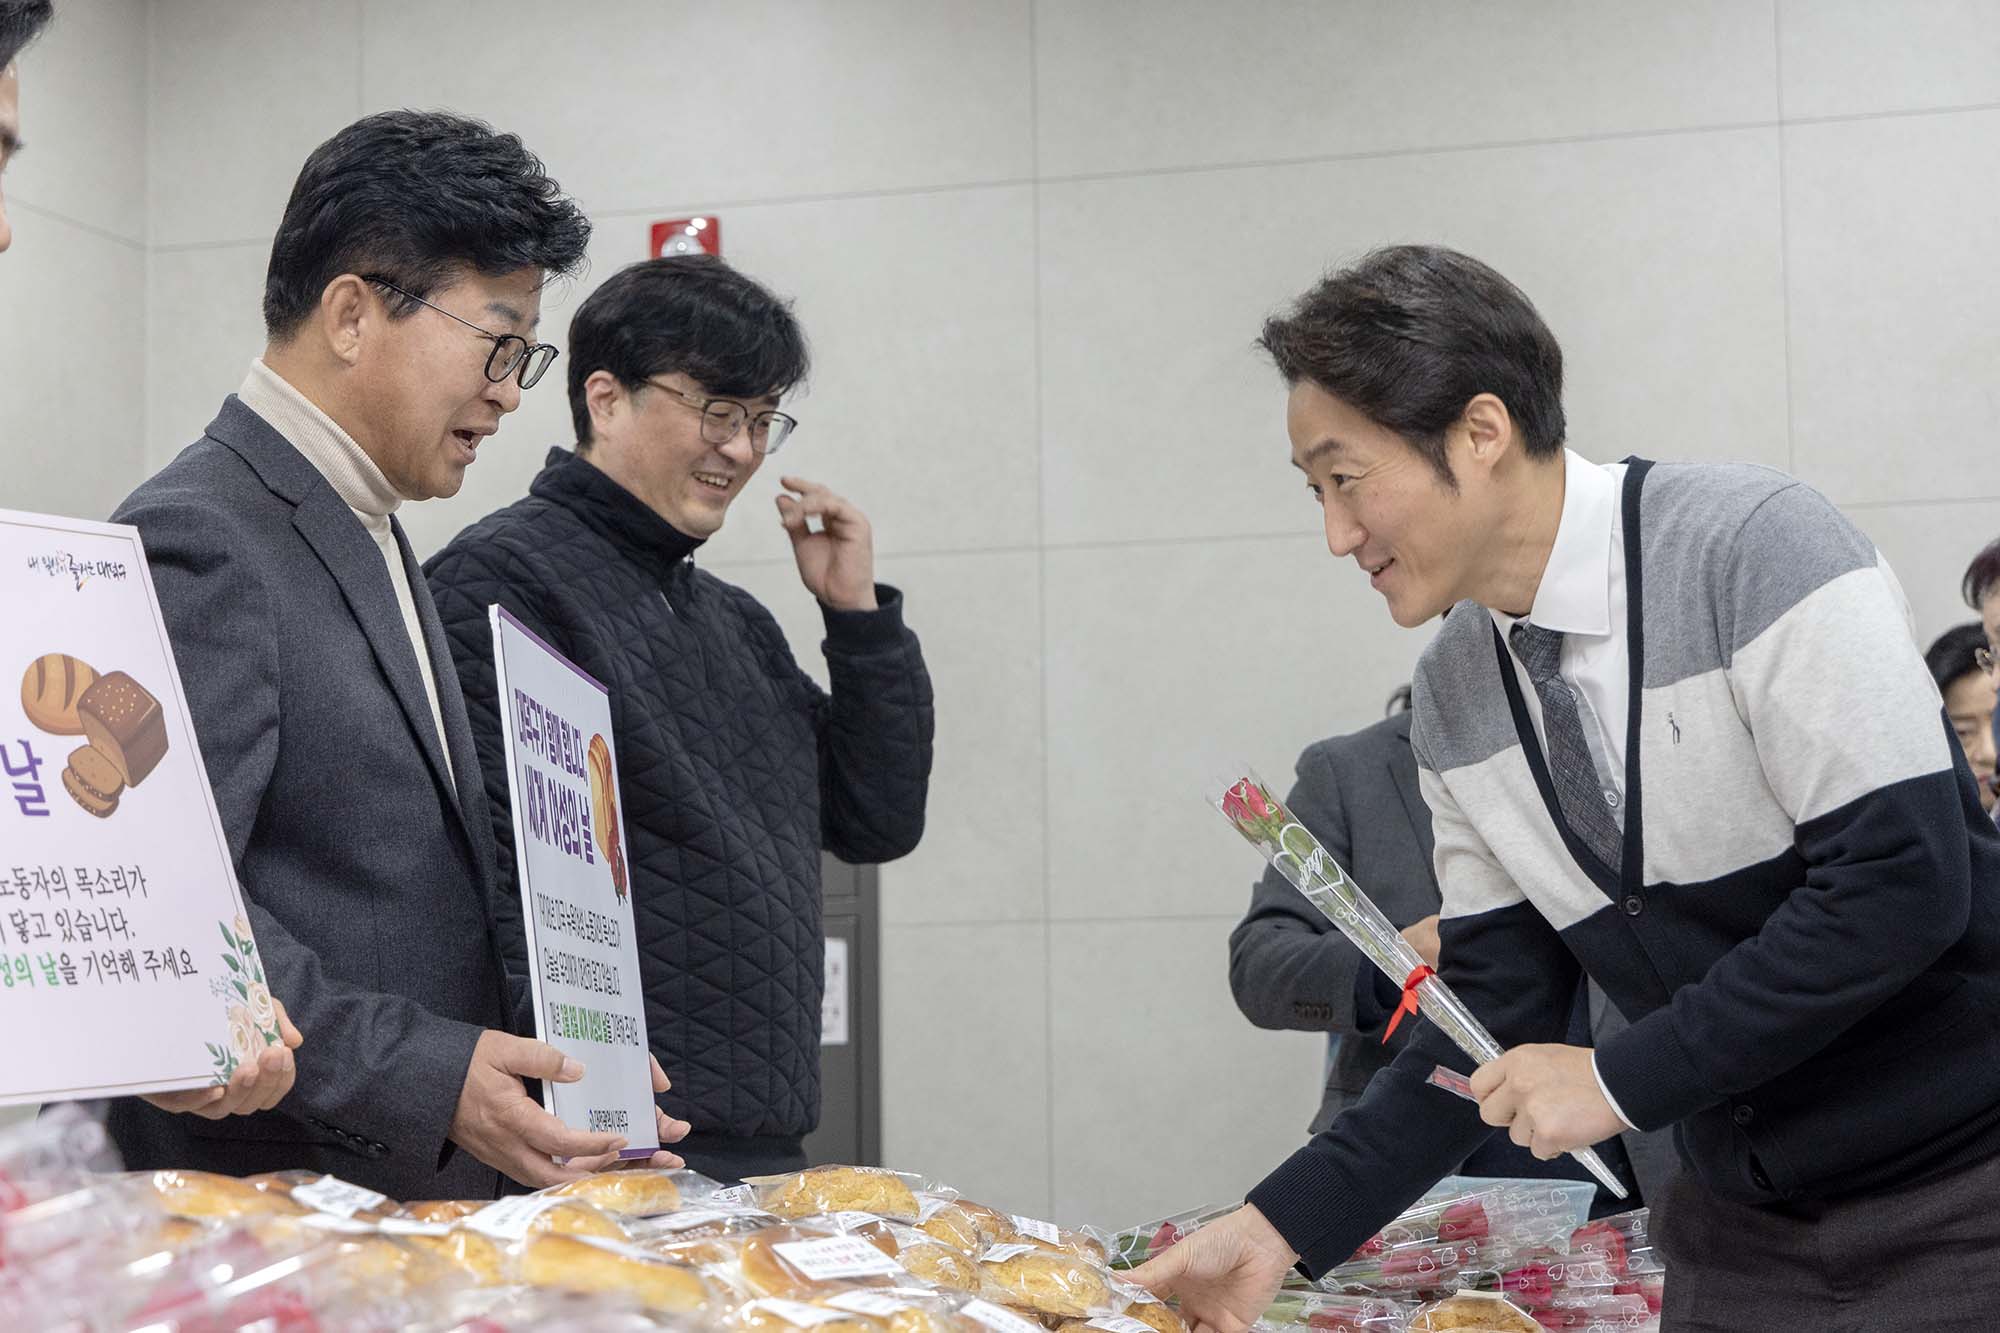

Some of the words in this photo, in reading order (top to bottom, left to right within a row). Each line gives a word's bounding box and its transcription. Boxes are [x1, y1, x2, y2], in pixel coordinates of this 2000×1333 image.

[27, 556, 39, 571] 내
[97, 561, 126, 581] 대덕구
[515, 688, 549, 760] 대덕구가
[545, 707, 564, 770] 함께
[0, 739, 50, 816] 날
[525, 764, 550, 845] 세계
[548, 777, 582, 860] 여성의
[578, 793, 595, 865] 날
[74, 865, 148, 899] 목소리가
[8, 908, 52, 944] 닿고
[54, 907, 136, 943] 있습니다.
[37, 951, 78, 986] 날을
[83, 949, 140, 985] 기억해
[142, 947, 199, 982] 주세요
